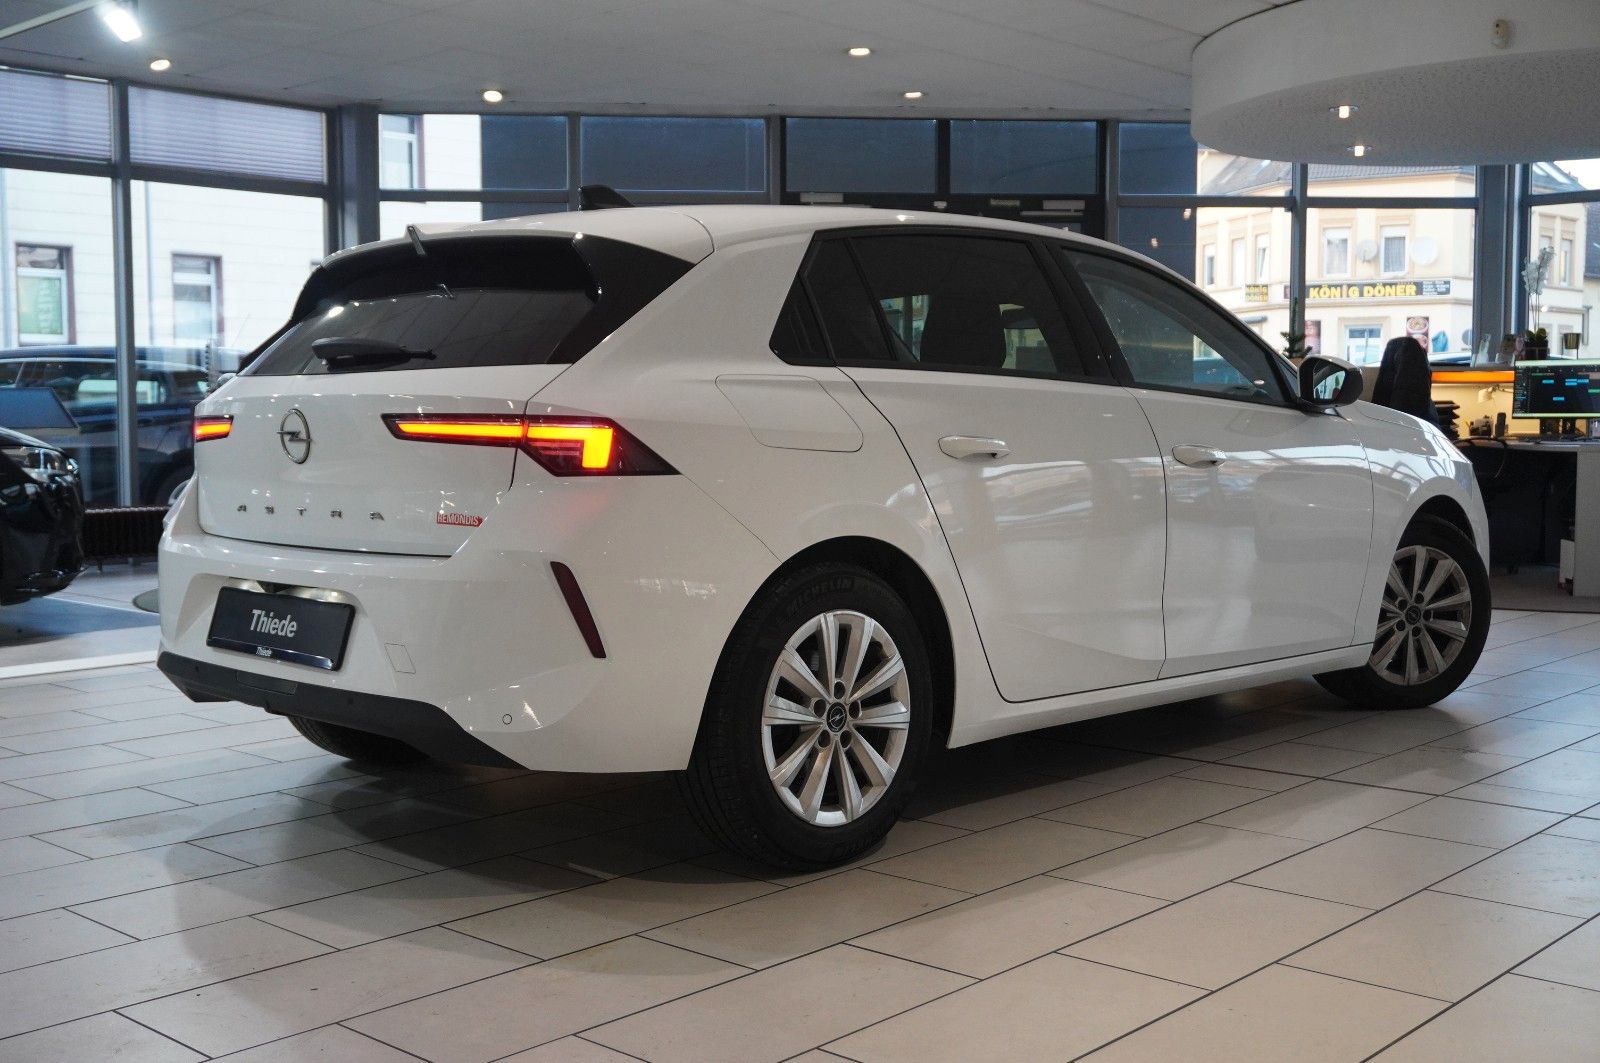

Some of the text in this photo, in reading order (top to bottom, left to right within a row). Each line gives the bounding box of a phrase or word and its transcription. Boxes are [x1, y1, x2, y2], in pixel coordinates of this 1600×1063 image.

[1309, 281, 1360, 298] KÖNIG
[1363, 281, 1417, 297] DÖNER
[237, 503, 385, 521] ASTRA
[437, 512, 479, 526] REMONDIS
[250, 609, 297, 637] Thiede
[256, 646, 272, 657] Thiede
